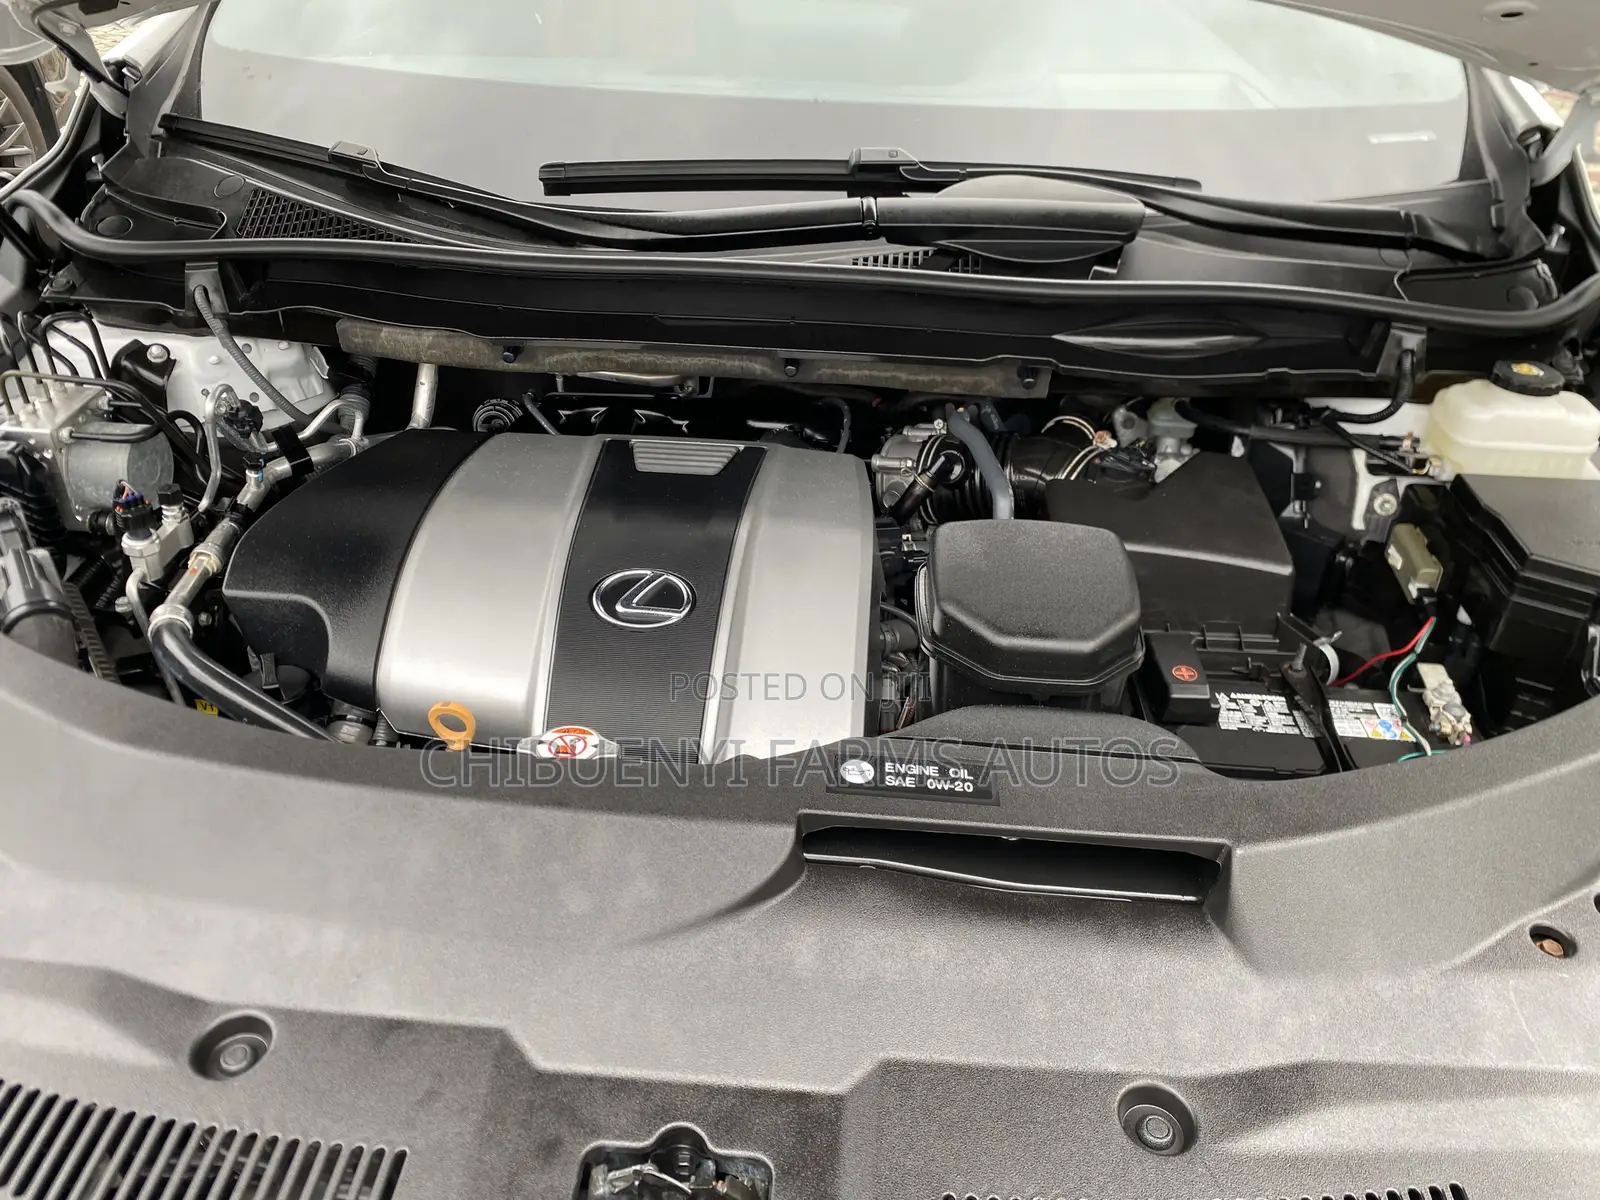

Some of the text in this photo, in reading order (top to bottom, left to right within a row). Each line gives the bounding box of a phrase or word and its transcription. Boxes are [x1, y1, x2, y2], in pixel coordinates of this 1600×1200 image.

[885, 763, 974, 779] ENGINE OIL
[885, 776, 916, 787] SAE
